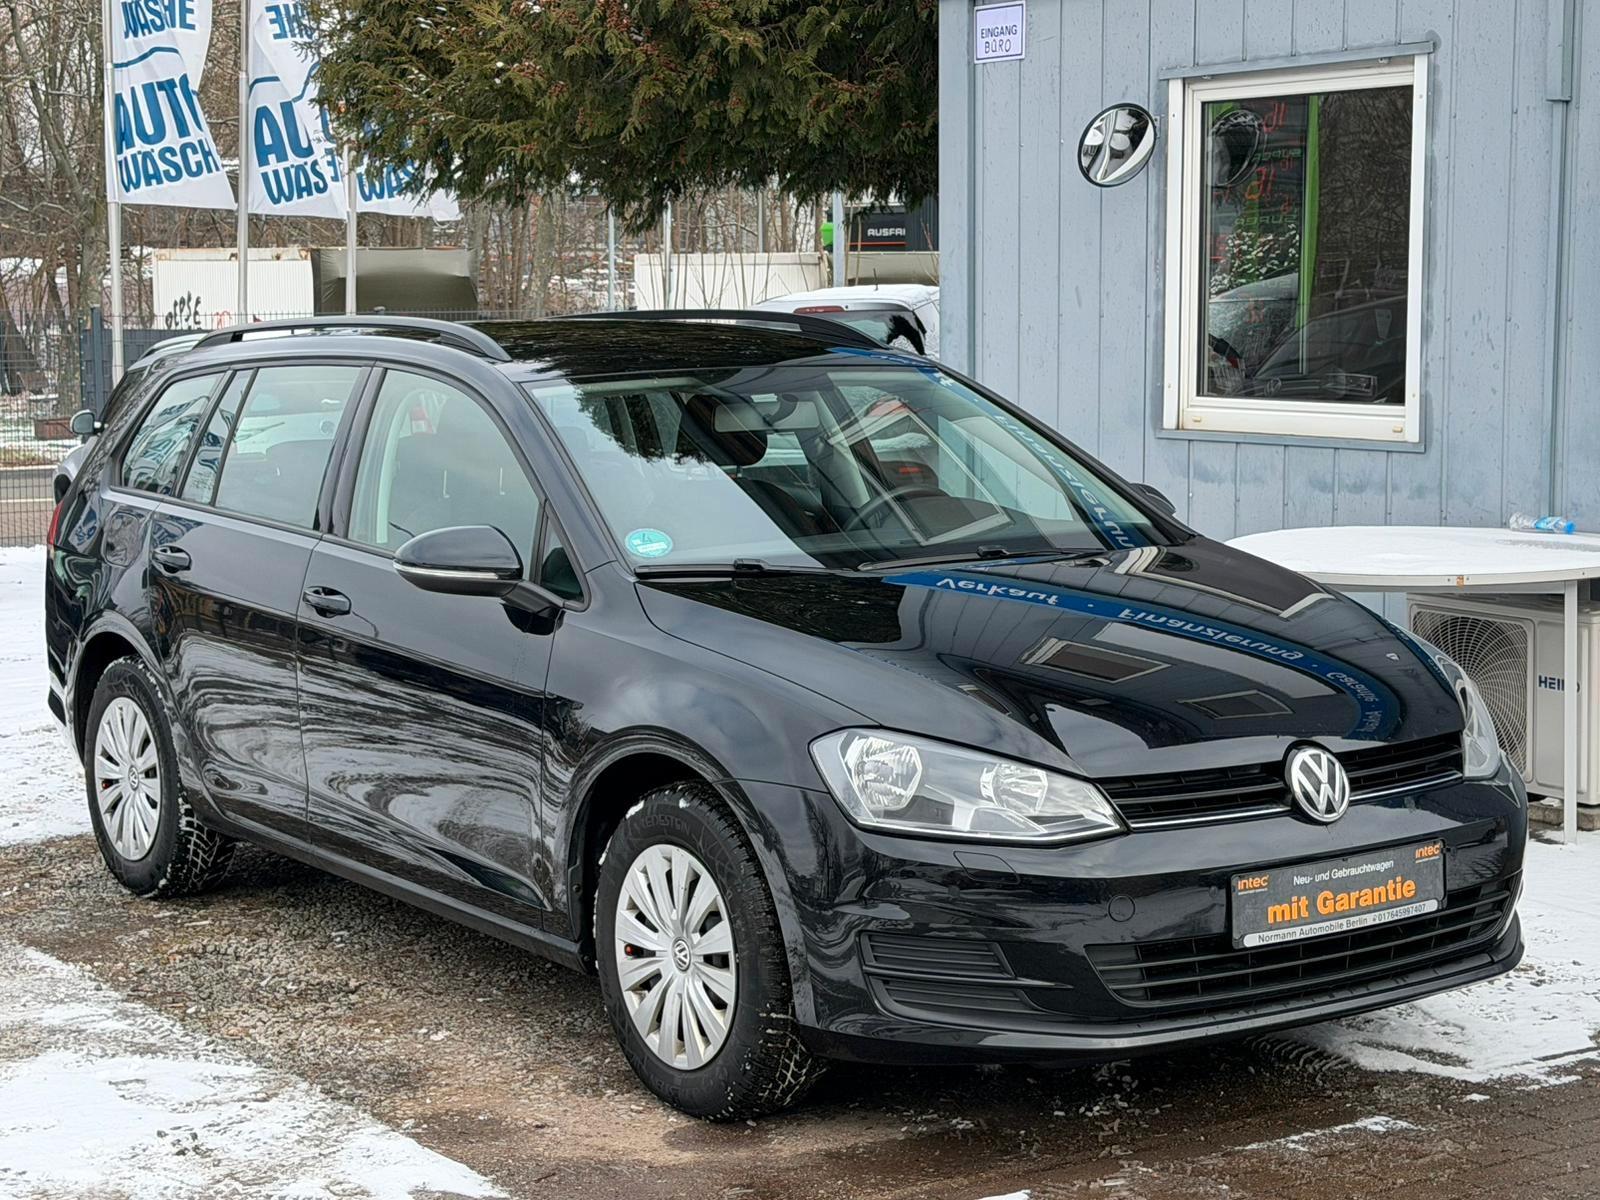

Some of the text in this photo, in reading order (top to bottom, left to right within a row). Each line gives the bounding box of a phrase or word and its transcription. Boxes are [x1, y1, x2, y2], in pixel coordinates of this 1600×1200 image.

[980, 24, 1018, 39] EINGANG
[254, 101, 315, 168] AU
[118, 138, 220, 193] WÄSCH
[260, 159, 329, 205] WÄS
[1293, 859, 1395, 886] Neu- und Gebrauchtwagen
[1267, 876, 1417, 924] mit Garantie
[1258, 930, 1297, 943] Normann
[1299, 921, 1344, 937] Automobile
[1346, 916, 1368, 929] Berlin
